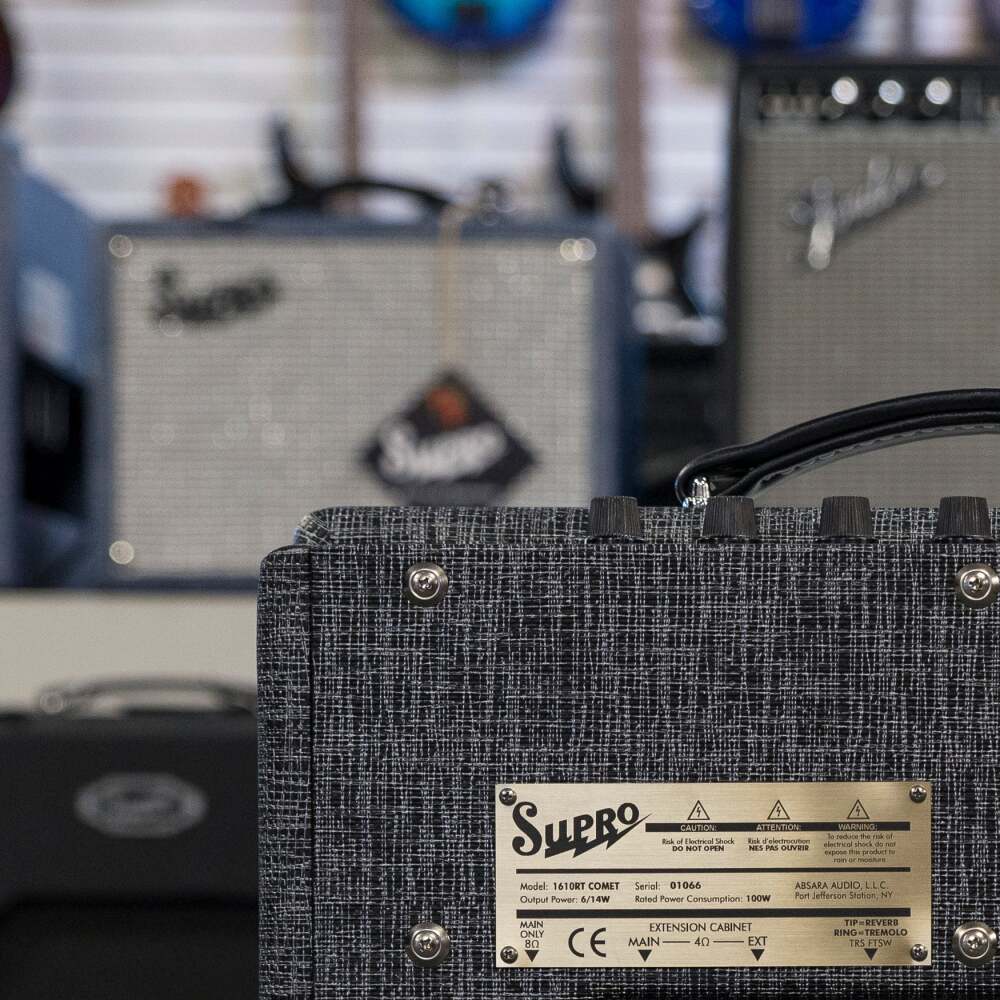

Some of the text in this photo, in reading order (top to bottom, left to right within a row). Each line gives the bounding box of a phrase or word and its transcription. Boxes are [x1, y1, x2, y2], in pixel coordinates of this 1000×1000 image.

[680, 824, 718, 832] CAUTION:
[755, 823, 802, 831] ATTENTION:
[838, 823, 878, 831] WARNING:
[862, 849, 887, 857] product
[520, 881, 620, 891] Model: 1610RT COMET
[635, 881, 702, 890] Serial: 01066
[795, 881, 889, 891] ABSARA AUDIO, L.L.C.
[520, 896, 548, 905] Output
[581, 895, 610, 904] 6/14W
[635, 894, 771, 904] Rated Power Consumption: 100W
[795, 891, 893, 900] Port Jefferson Station, NY
[649, 922, 752, 932] EXTENSION CABINET
[520, 930, 544, 938] ONLY
[525, 940, 540, 948] 8Ω
[628, 936, 660, 947] MAIN
[748, 936, 768, 946] EXT
[849, 938, 892, 947] TRS FTSW
